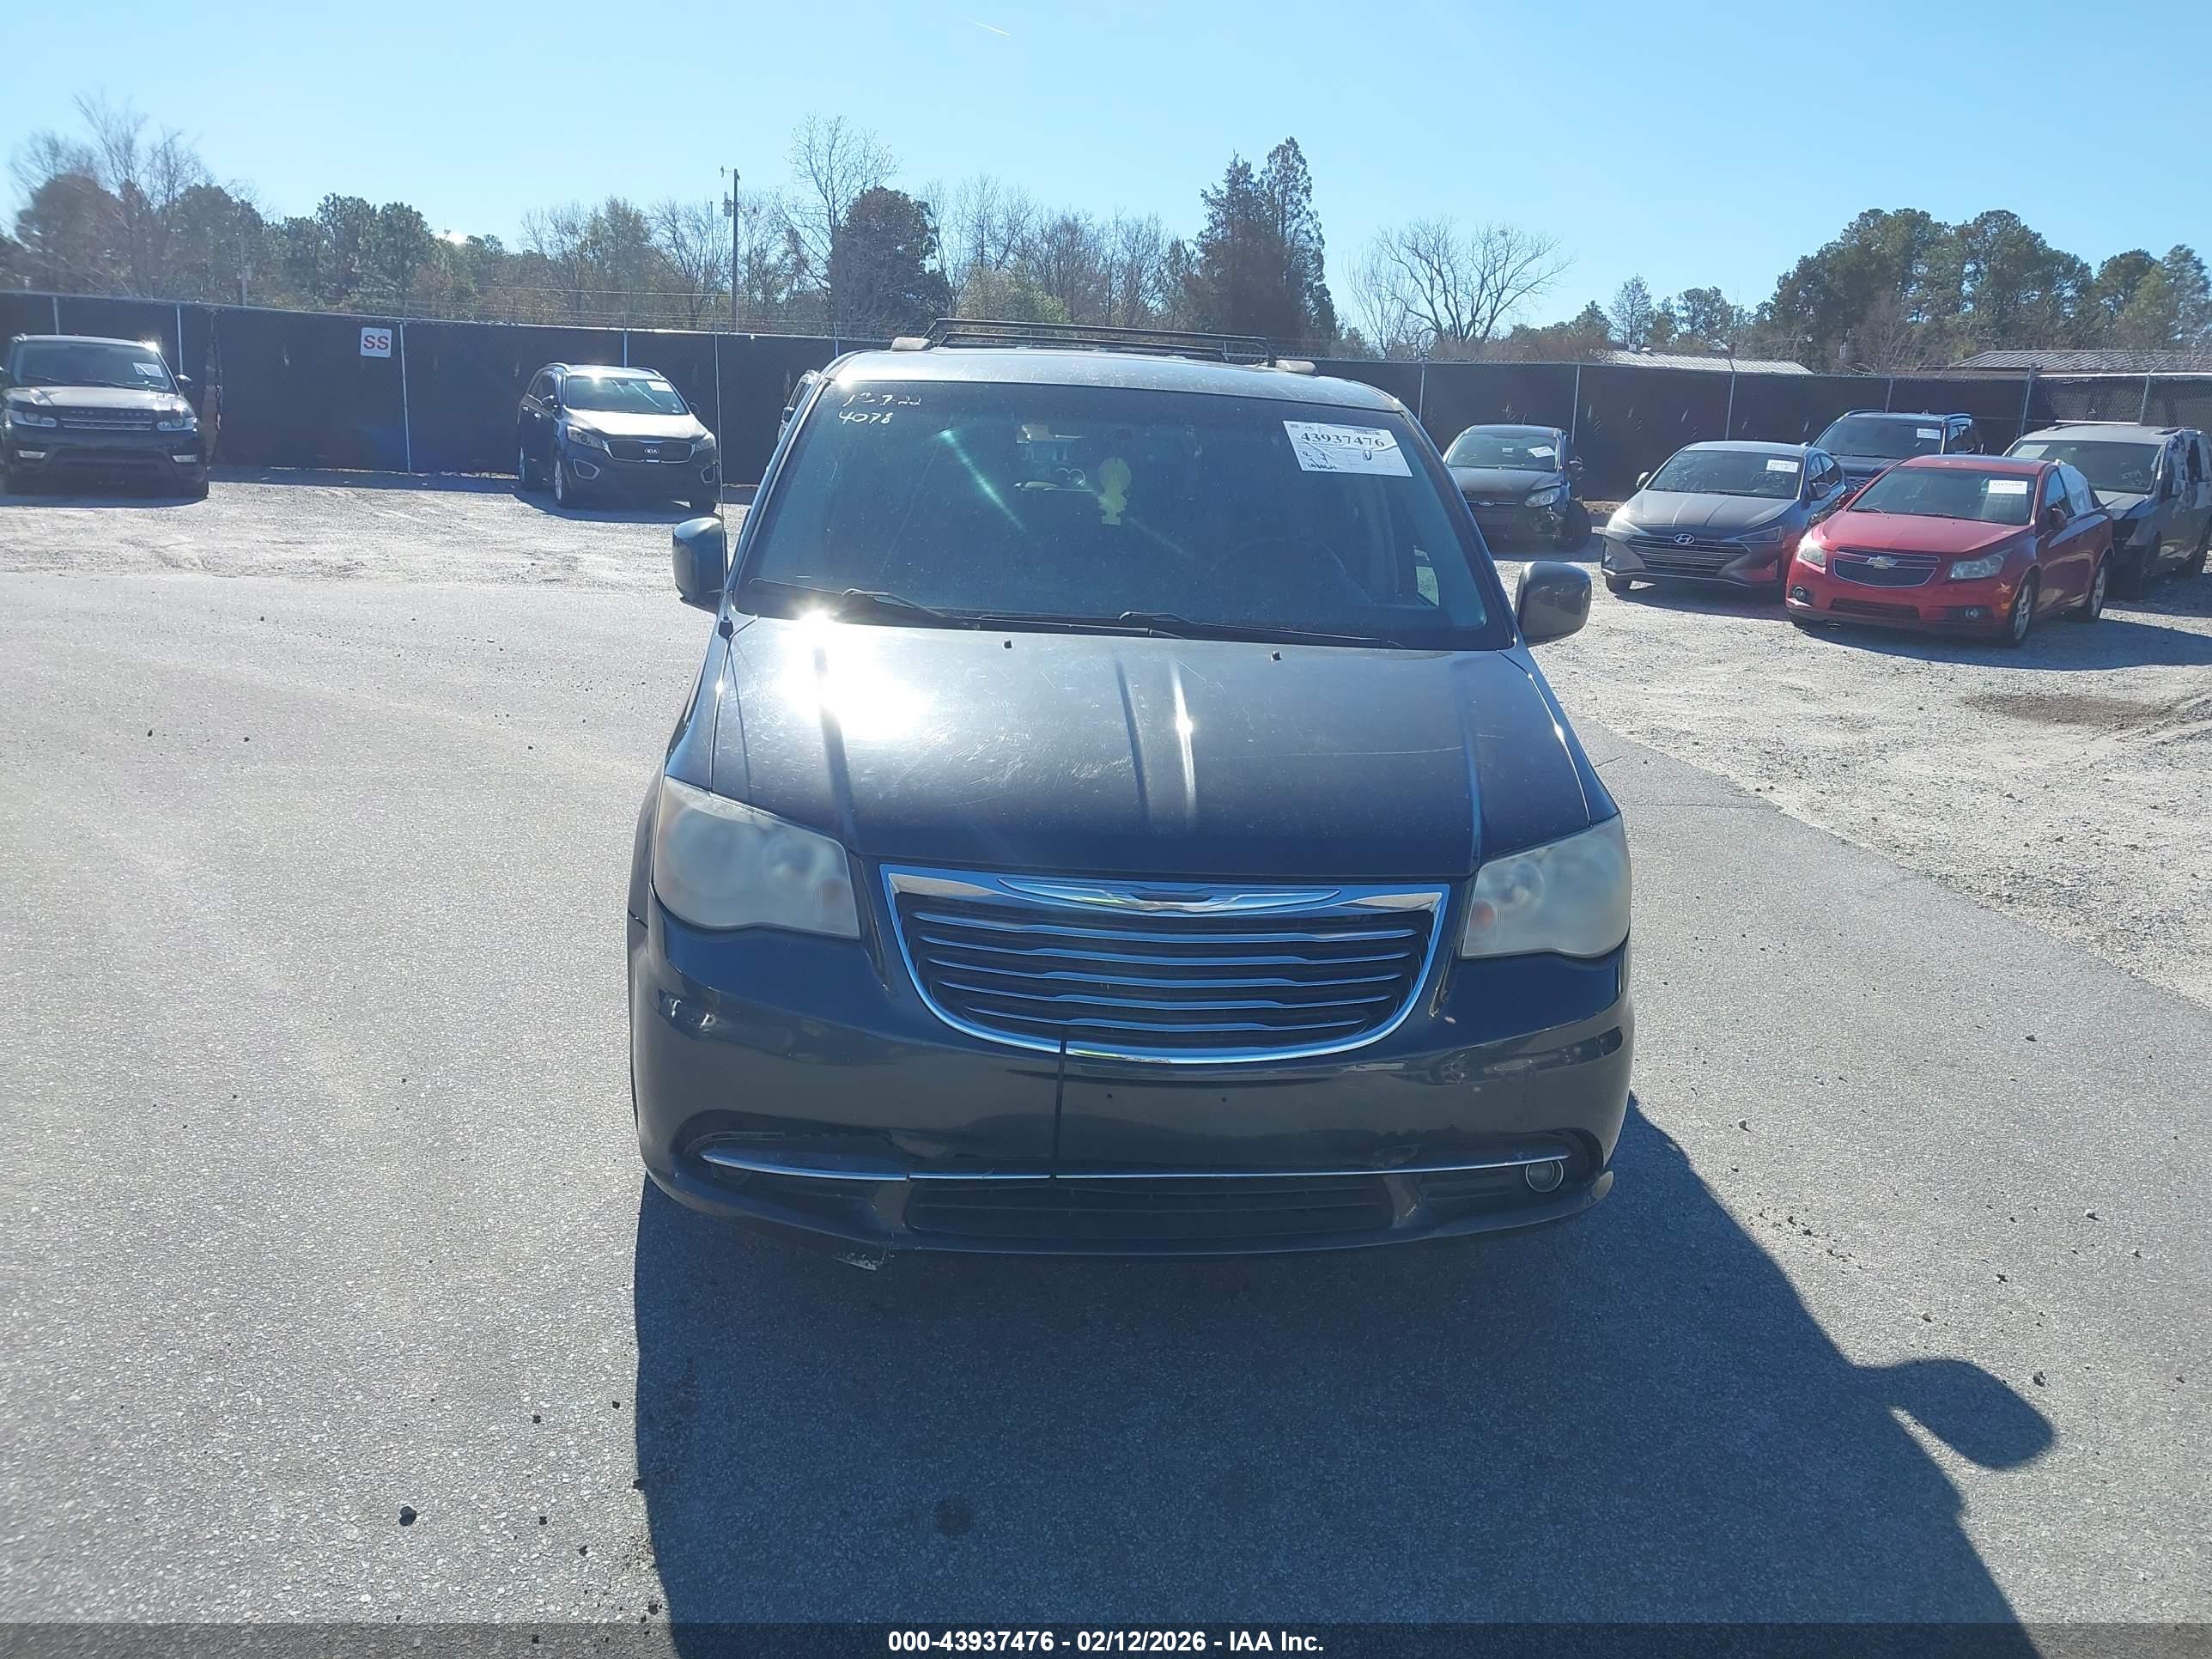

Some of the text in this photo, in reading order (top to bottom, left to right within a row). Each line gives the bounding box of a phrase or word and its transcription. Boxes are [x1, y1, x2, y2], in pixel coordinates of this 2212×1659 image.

[363, 335, 389, 350] SS
[838, 410, 894, 425] 4078
[1300, 432, 1385, 447] 43937476
